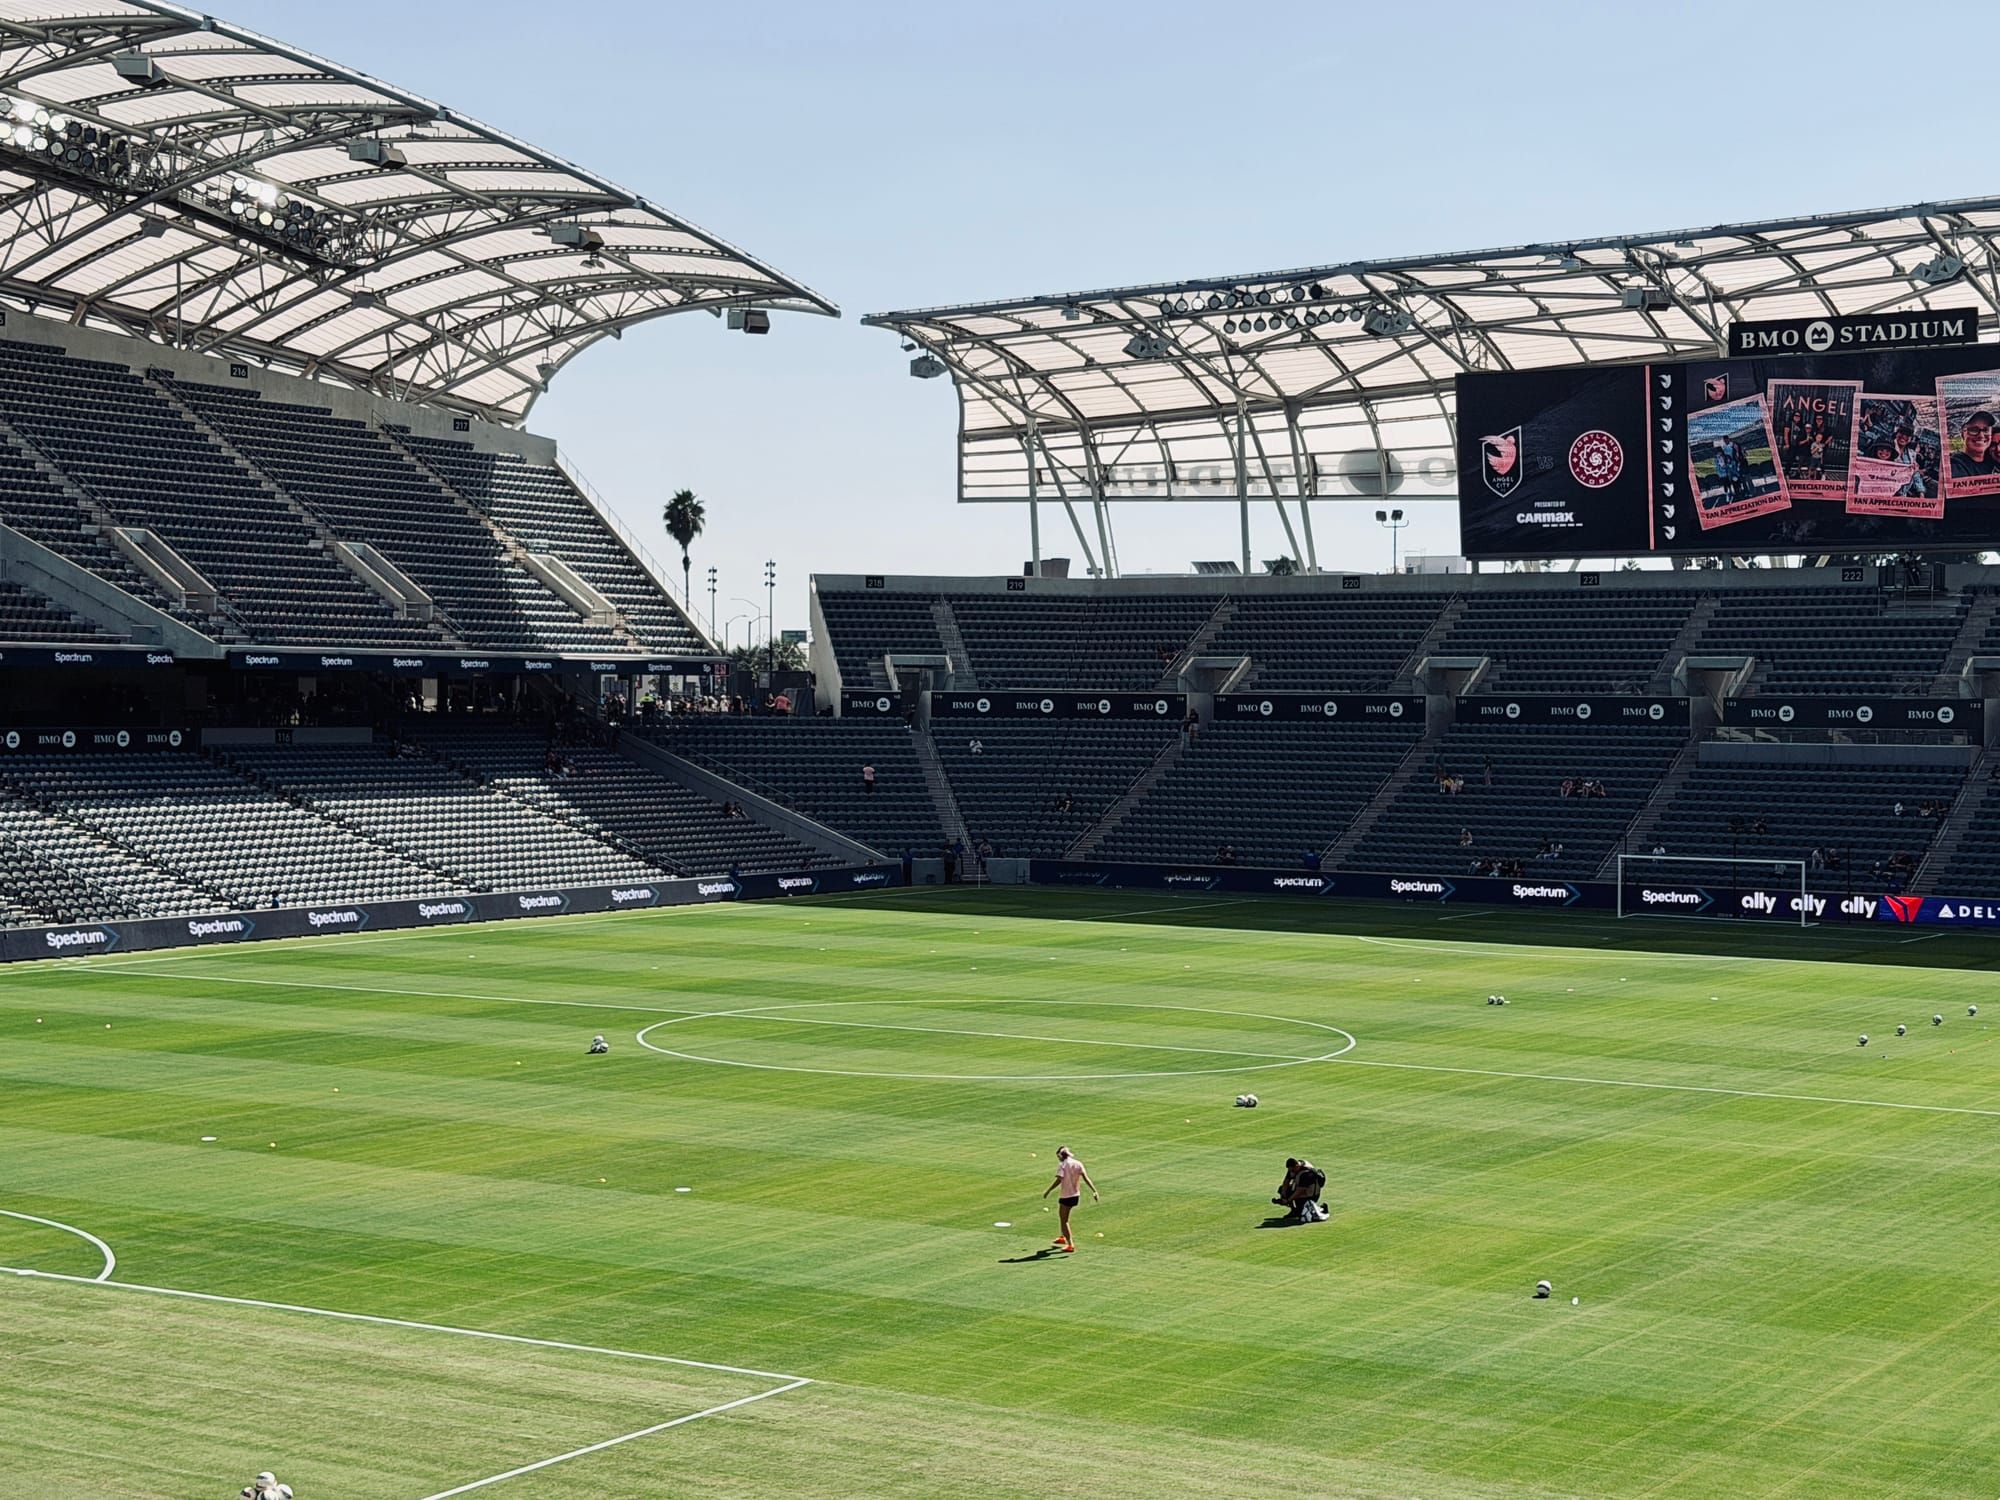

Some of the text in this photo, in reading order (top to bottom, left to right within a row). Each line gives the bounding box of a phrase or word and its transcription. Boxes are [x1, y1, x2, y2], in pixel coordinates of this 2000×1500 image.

[1740, 319, 1964, 350] BMO STADIUM
[232, 367, 247, 377] 216
[1783, 394, 1847, 416] ANGEL
[455, 421, 468, 430] 217
[1573, 433, 1619, 454] PORTLAND
[1953, 480, 1968, 488] FAN
[1705, 495, 1782, 519] FAN APPRECIATION DAY
[1853, 497, 1937, 508] FAN APPRECIATION DAY
[1582, 575, 1598, 585] 221
[1844, 570, 1862, 581] 222
[867, 578, 882, 588] 218
[1008, 580, 1024, 590] 219
[1343, 578, 1359, 588] 220
[55, 652, 92, 663] Spectrum
[246, 655, 279, 665] Spectrum
[321, 656, 352, 667] Spectrum
[393, 658, 423, 667] Spectrum
[461, 659, 489, 668] Spectrum
[525, 660, 552, 670] Spectrum
[591, 662, 617, 671] Spectrum
[648, 663, 672, 672] Spectrum
[852, 700, 874, 708] BMO
[1133, 703, 1154, 711] BMO
[1237, 704, 1258, 712] BMO
[1366, 705, 1387, 713] BMO
[1551, 707, 1574, 715] BMO
[1623, 708, 1647, 716] BMO
[1751, 709, 1776, 717] BMO
[1828, 710, 1854, 718] BMO
[1908, 710, 1934, 719] BMO
[39, 735, 60, 744] BMO
[94, 735, 114, 743] BMO
[147, 734, 168, 743] BMO
[698, 880, 735, 896] Spectrum
[778, 876, 813, 890] Spectrum
[1391, 879, 1441, 894] Spectrum
[611, 887, 651, 903] Spectrum
[1513, 884, 1566, 899] Spectrum
[519, 893, 562, 911] Spectrum
[1642, 890, 1698, 905] Spectrum
[1741, 892, 1776, 914] ally
[1790, 894, 1826, 917] ally
[1841, 896, 1877, 918] ally
[419, 901, 464, 919] Spectrum
[308, 910, 358, 928] Spectrum
[188, 919, 243, 938] Spectrum
[46, 930, 106, 949] Spectrum
